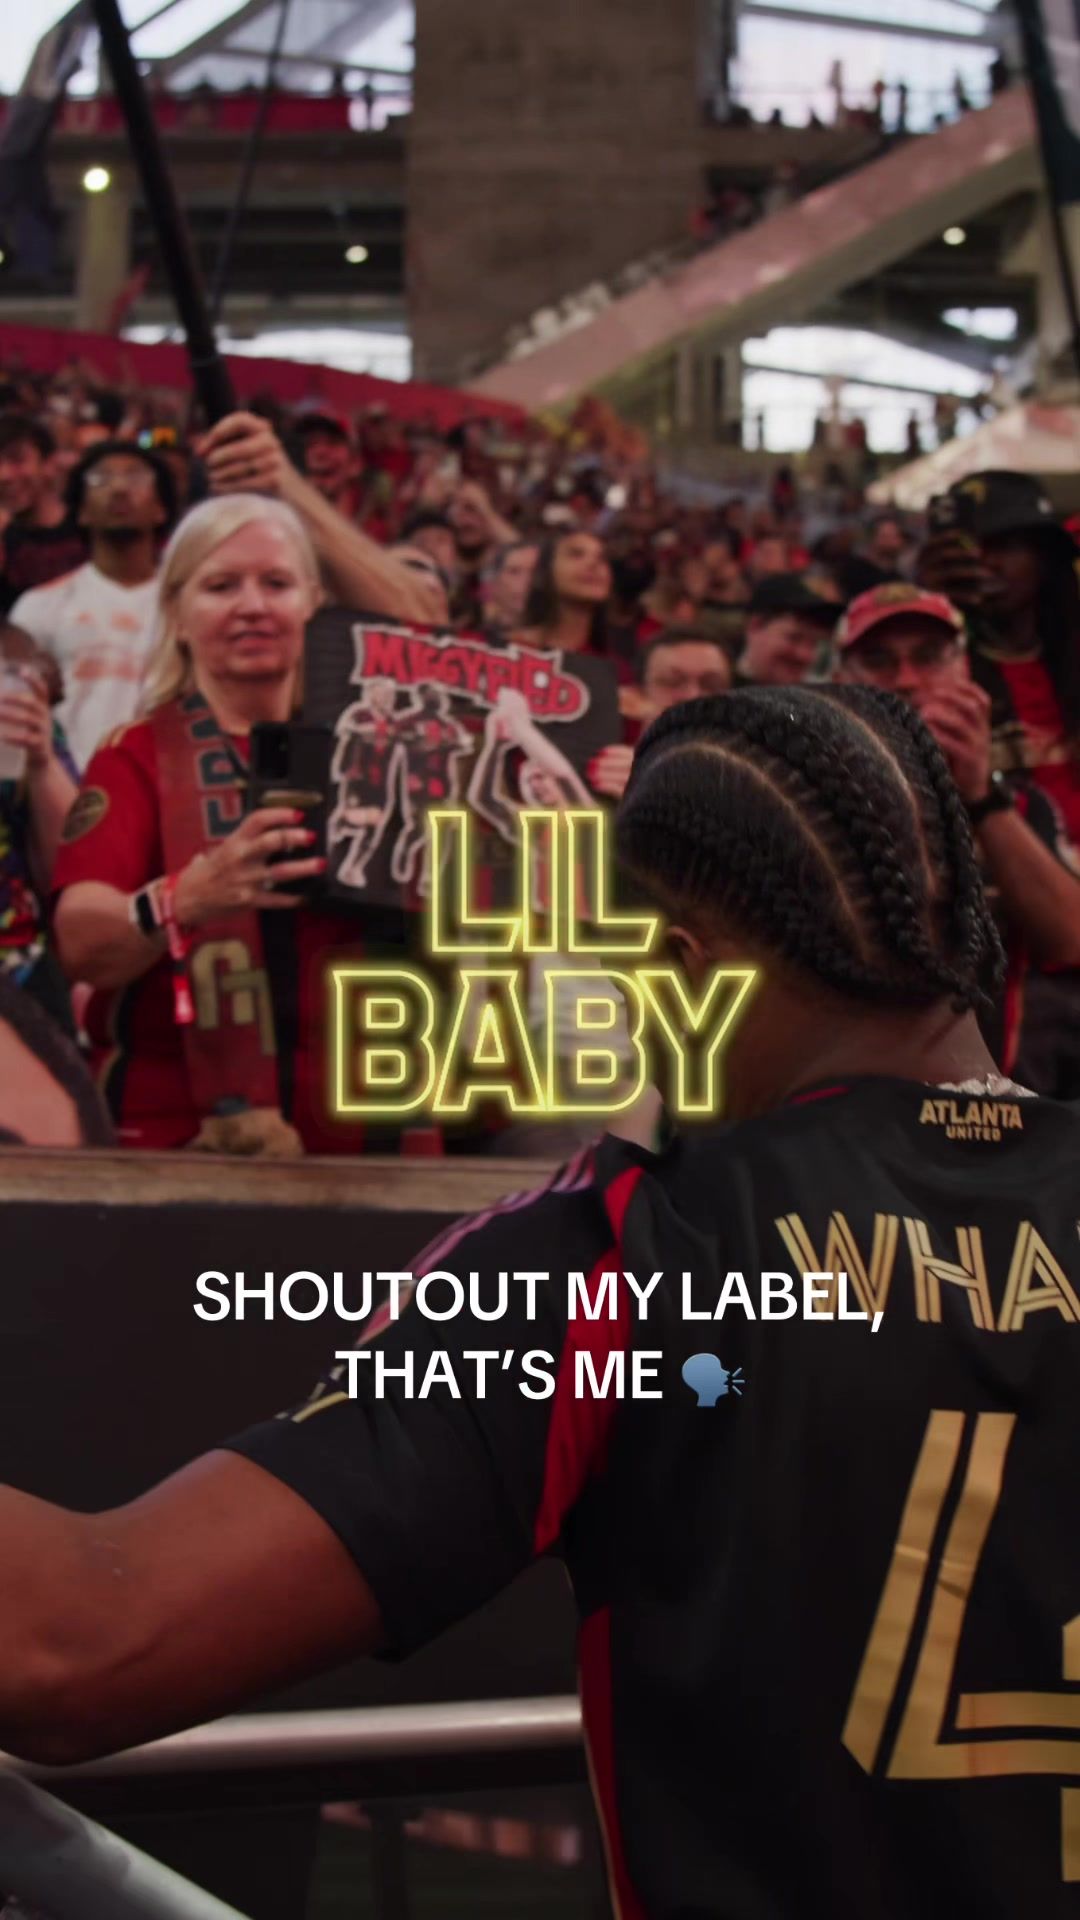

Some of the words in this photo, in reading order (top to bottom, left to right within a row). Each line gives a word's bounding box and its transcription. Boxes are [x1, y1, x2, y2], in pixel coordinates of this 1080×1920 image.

[919, 1099, 1023, 1129] ATLANTA
[946, 1125, 1002, 1142] UNITED
[774, 1210, 1080, 1333] WHA
